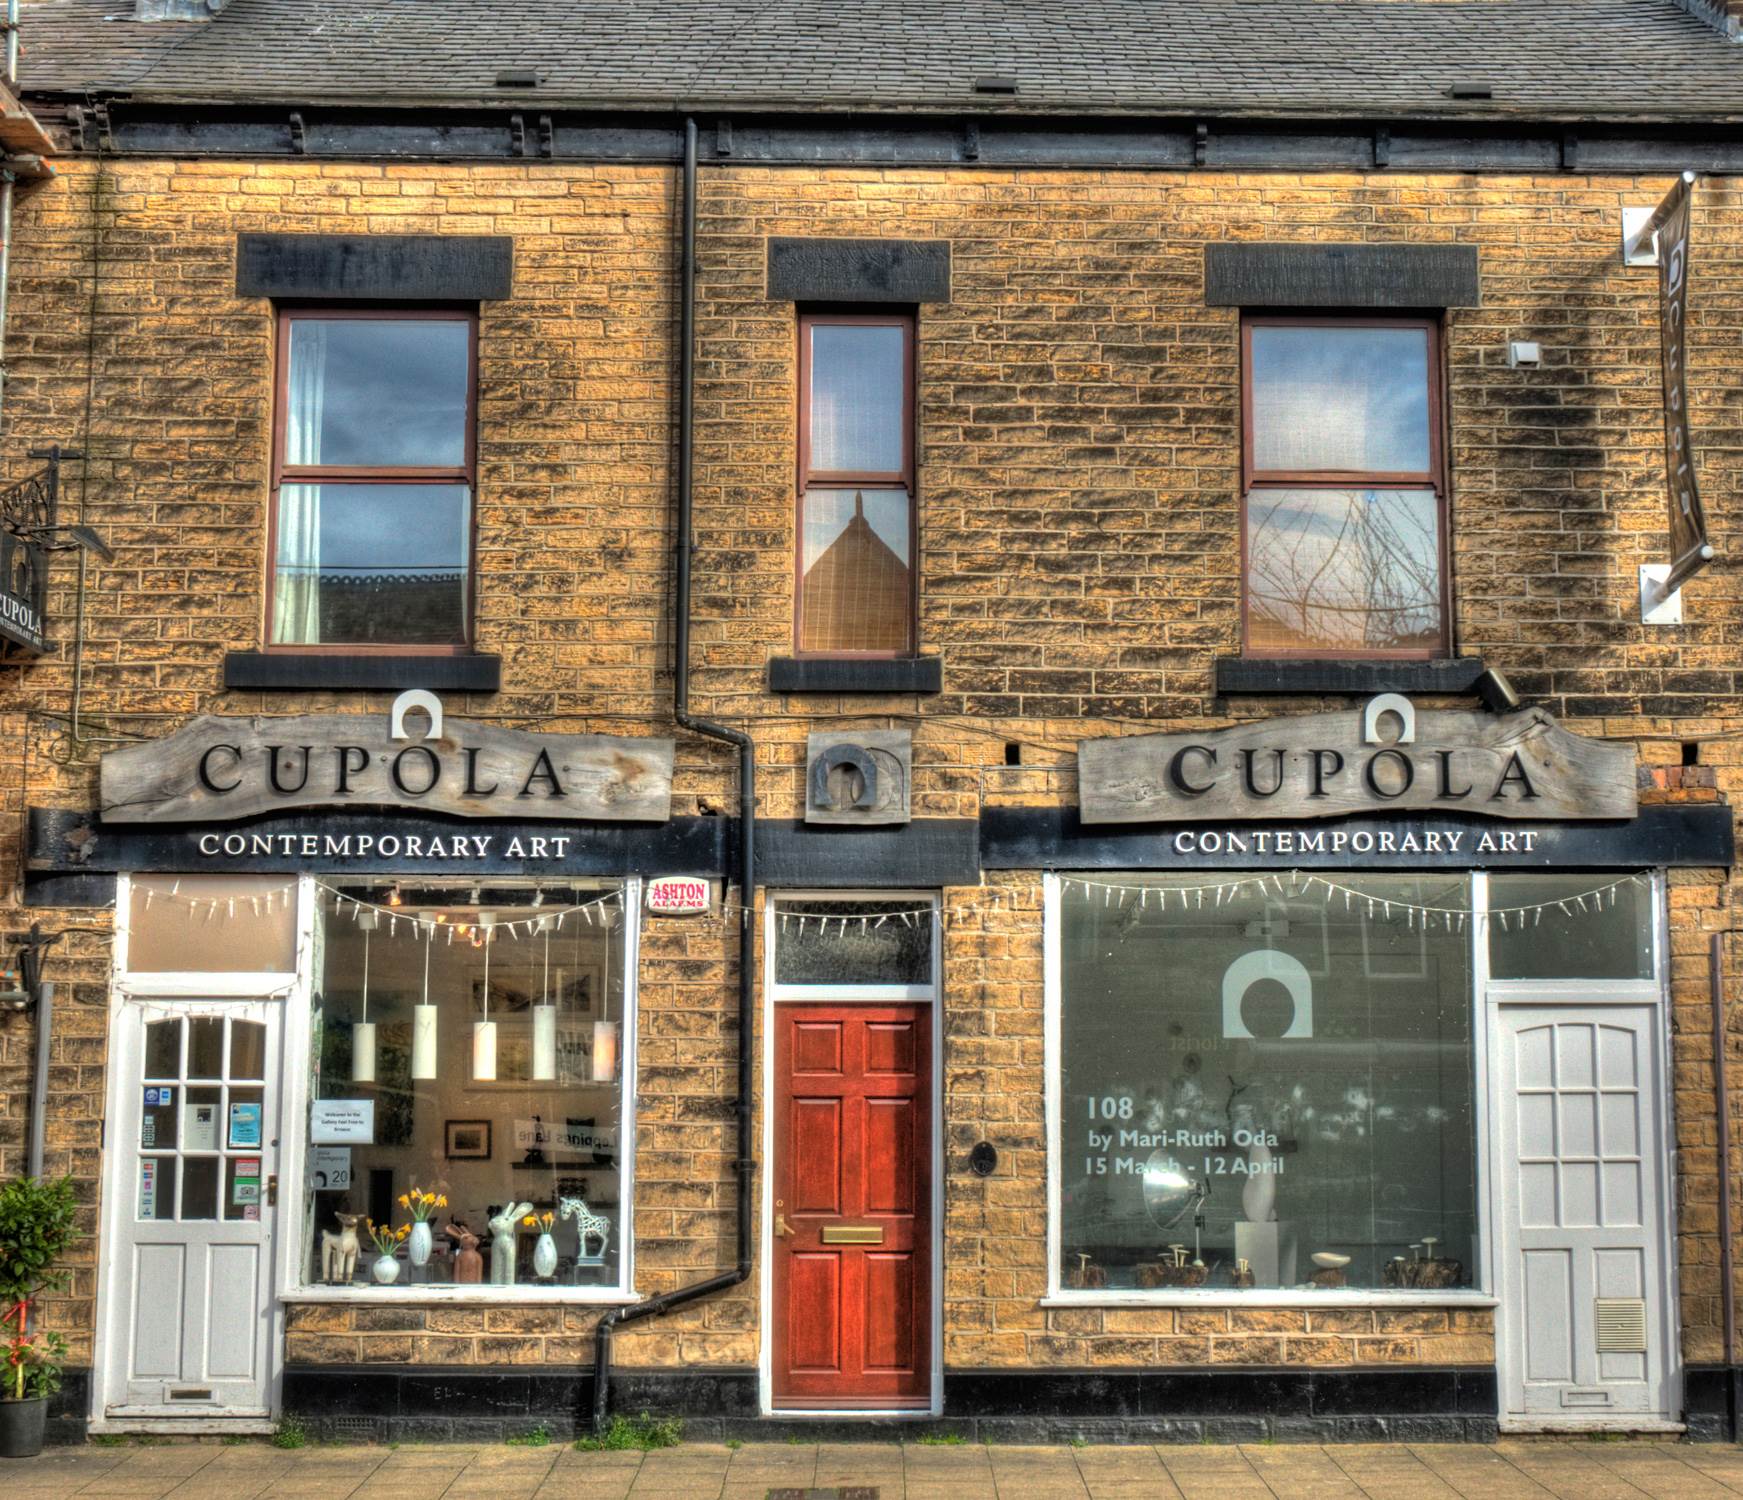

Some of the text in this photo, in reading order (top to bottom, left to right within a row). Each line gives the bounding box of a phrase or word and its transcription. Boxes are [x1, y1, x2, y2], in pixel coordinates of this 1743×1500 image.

[198, 744, 567, 796] CUPOLA
[1169, 745, 1541, 799] CUPOLA
[199, 834, 571, 857] CONTEMPORARY ART
[1174, 831, 1539, 854] CONTEMPORARY ART
[652, 882, 705, 899] ASHTON
[1088, 1096, 1134, 1119] 108
[1088, 1129, 1279, 1152] by Mari-Ruth Oda
[332, 1169, 348, 1183] 20
[1085, 1157, 1107, 1174] 15
[1204, 1157, 1227, 1174] 12
[1231, 1157, 1284, 1178] April
